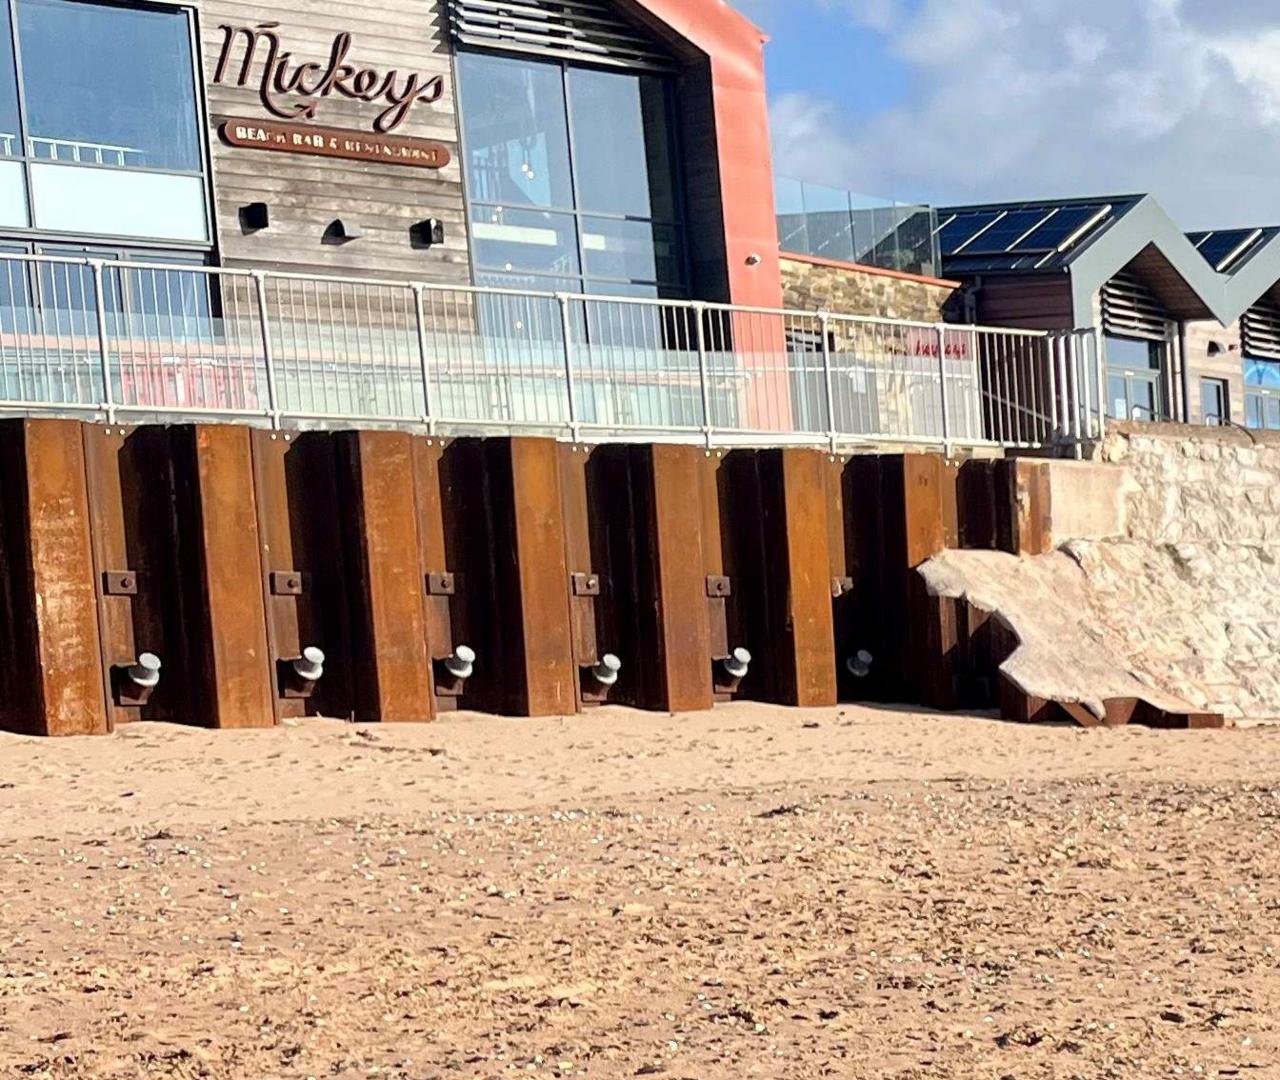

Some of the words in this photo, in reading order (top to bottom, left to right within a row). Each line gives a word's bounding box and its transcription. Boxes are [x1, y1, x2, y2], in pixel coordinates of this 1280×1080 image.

[213, 21, 444, 133] Mickeys
[293, 133, 324, 148] BAR
[329, 137, 338, 150] &
